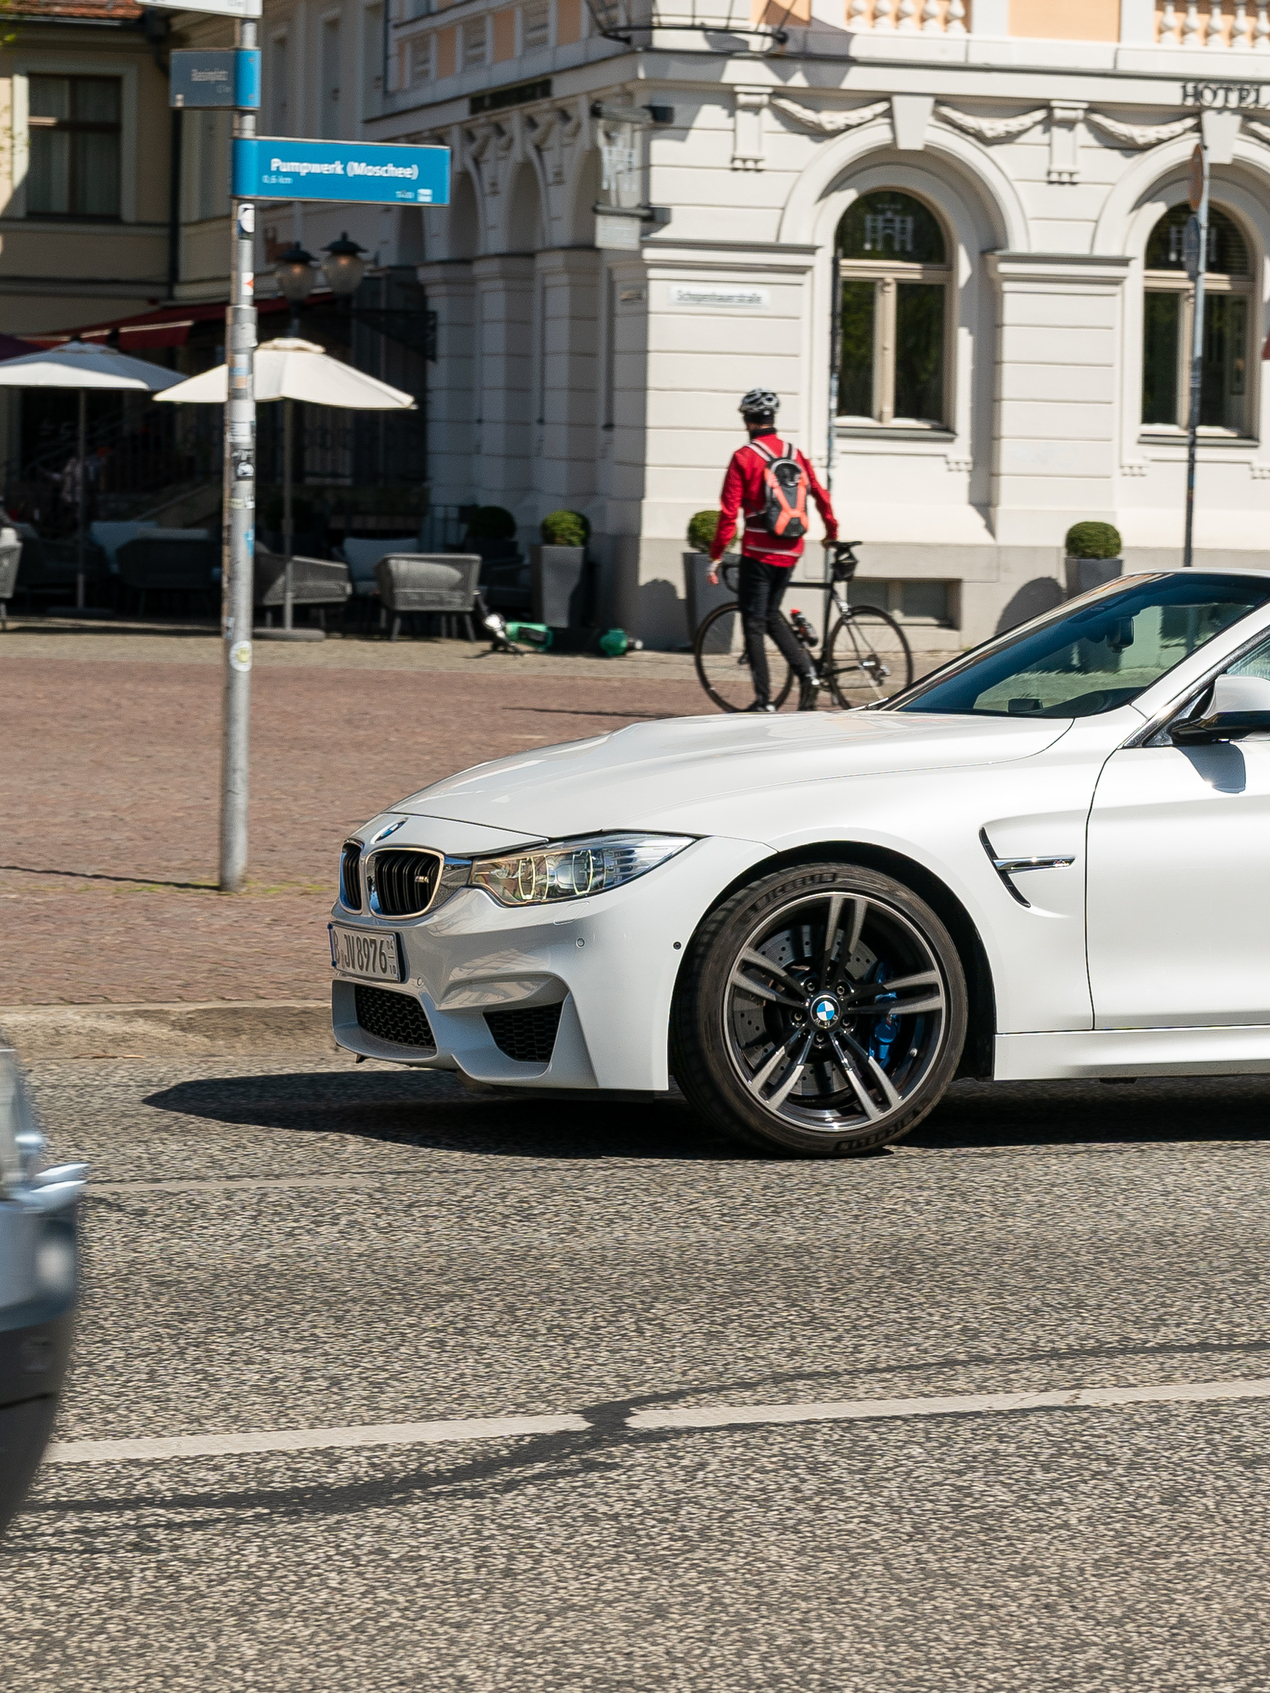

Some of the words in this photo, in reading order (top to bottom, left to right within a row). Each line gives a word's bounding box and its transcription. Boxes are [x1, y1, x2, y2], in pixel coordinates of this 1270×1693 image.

[1182, 84, 1270, 107] HOTEL
[270, 158, 344, 176] Pumpwerk
[346, 161, 419, 180] (Moschee)
